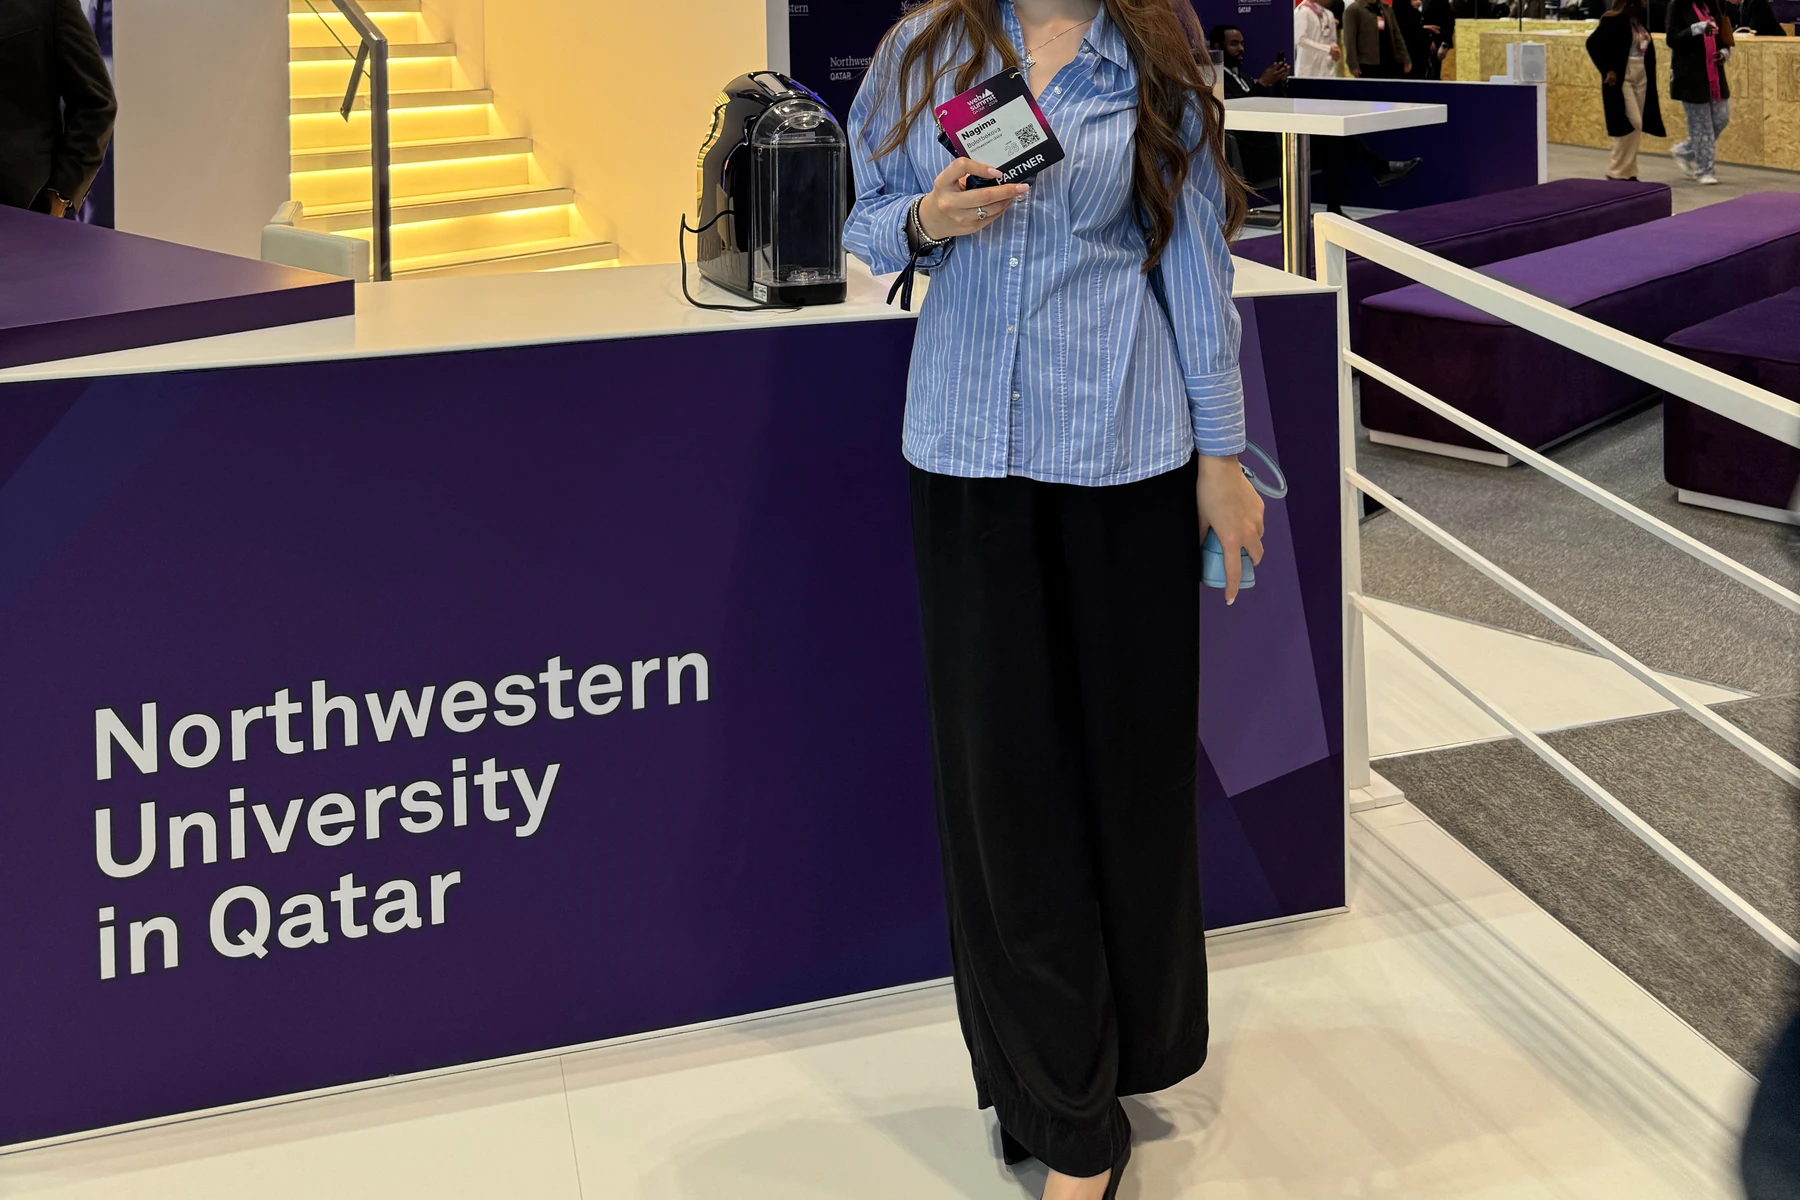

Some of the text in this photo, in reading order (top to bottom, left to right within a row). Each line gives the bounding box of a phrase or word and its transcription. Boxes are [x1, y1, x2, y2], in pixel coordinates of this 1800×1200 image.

[1237, 6, 1252, 14] QATAR
[830, 56, 872, 67] Northwest
[830, 72, 852, 81] QATAR
[966, 94, 983, 107] web
[969, 94, 997, 112] summit
[973, 106, 986, 115] QATAR
[961, 117, 997, 141] Nagima
[996, 153, 1046, 186] PARTNER
[94, 651, 711, 781] Northwestern
[94, 757, 562, 879] University
[98, 870, 462, 981] in Qatar
